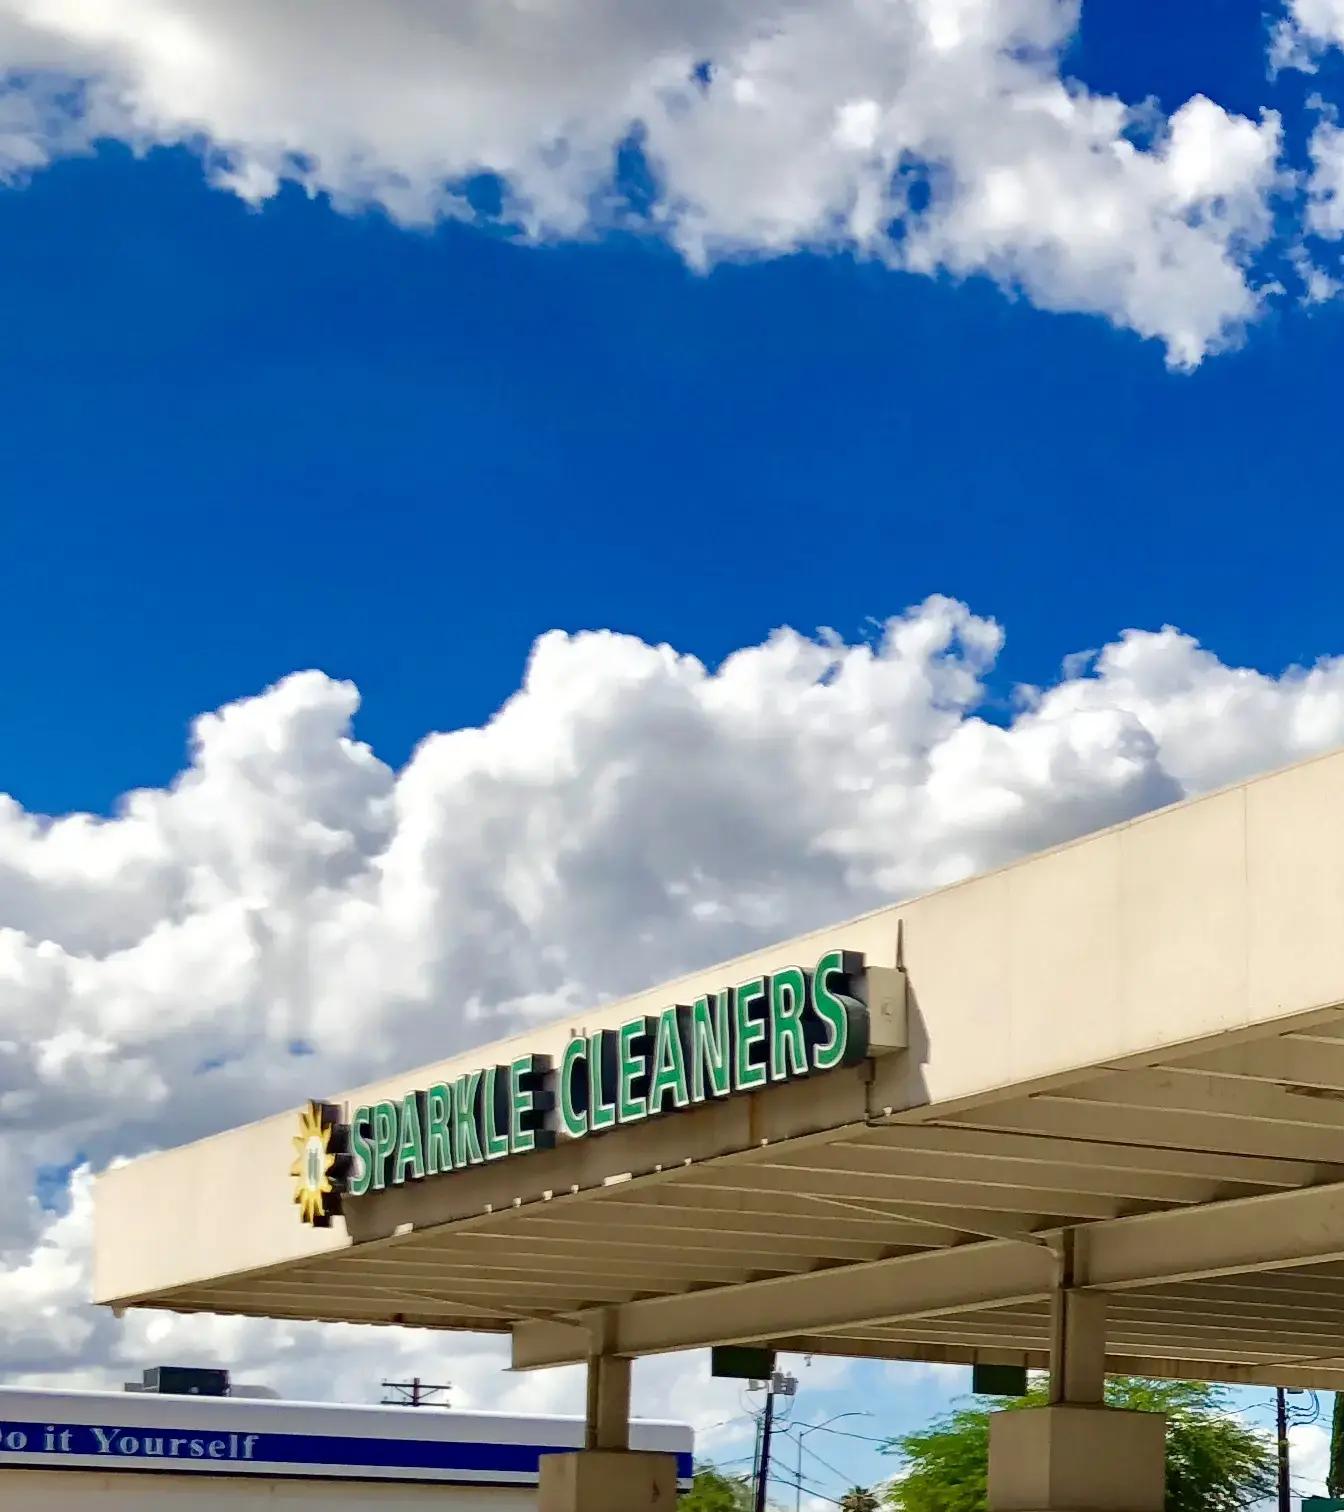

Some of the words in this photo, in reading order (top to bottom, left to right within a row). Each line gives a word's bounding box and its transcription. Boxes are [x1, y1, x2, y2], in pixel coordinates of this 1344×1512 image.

[349, 1052, 536, 1196] SPARKLE
[558, 949, 850, 1138] CLEANERS
[0, 1427, 28, 1451] o
[44, 1425, 73, 1452] it
[90, 1427, 260, 1459] Yourself
